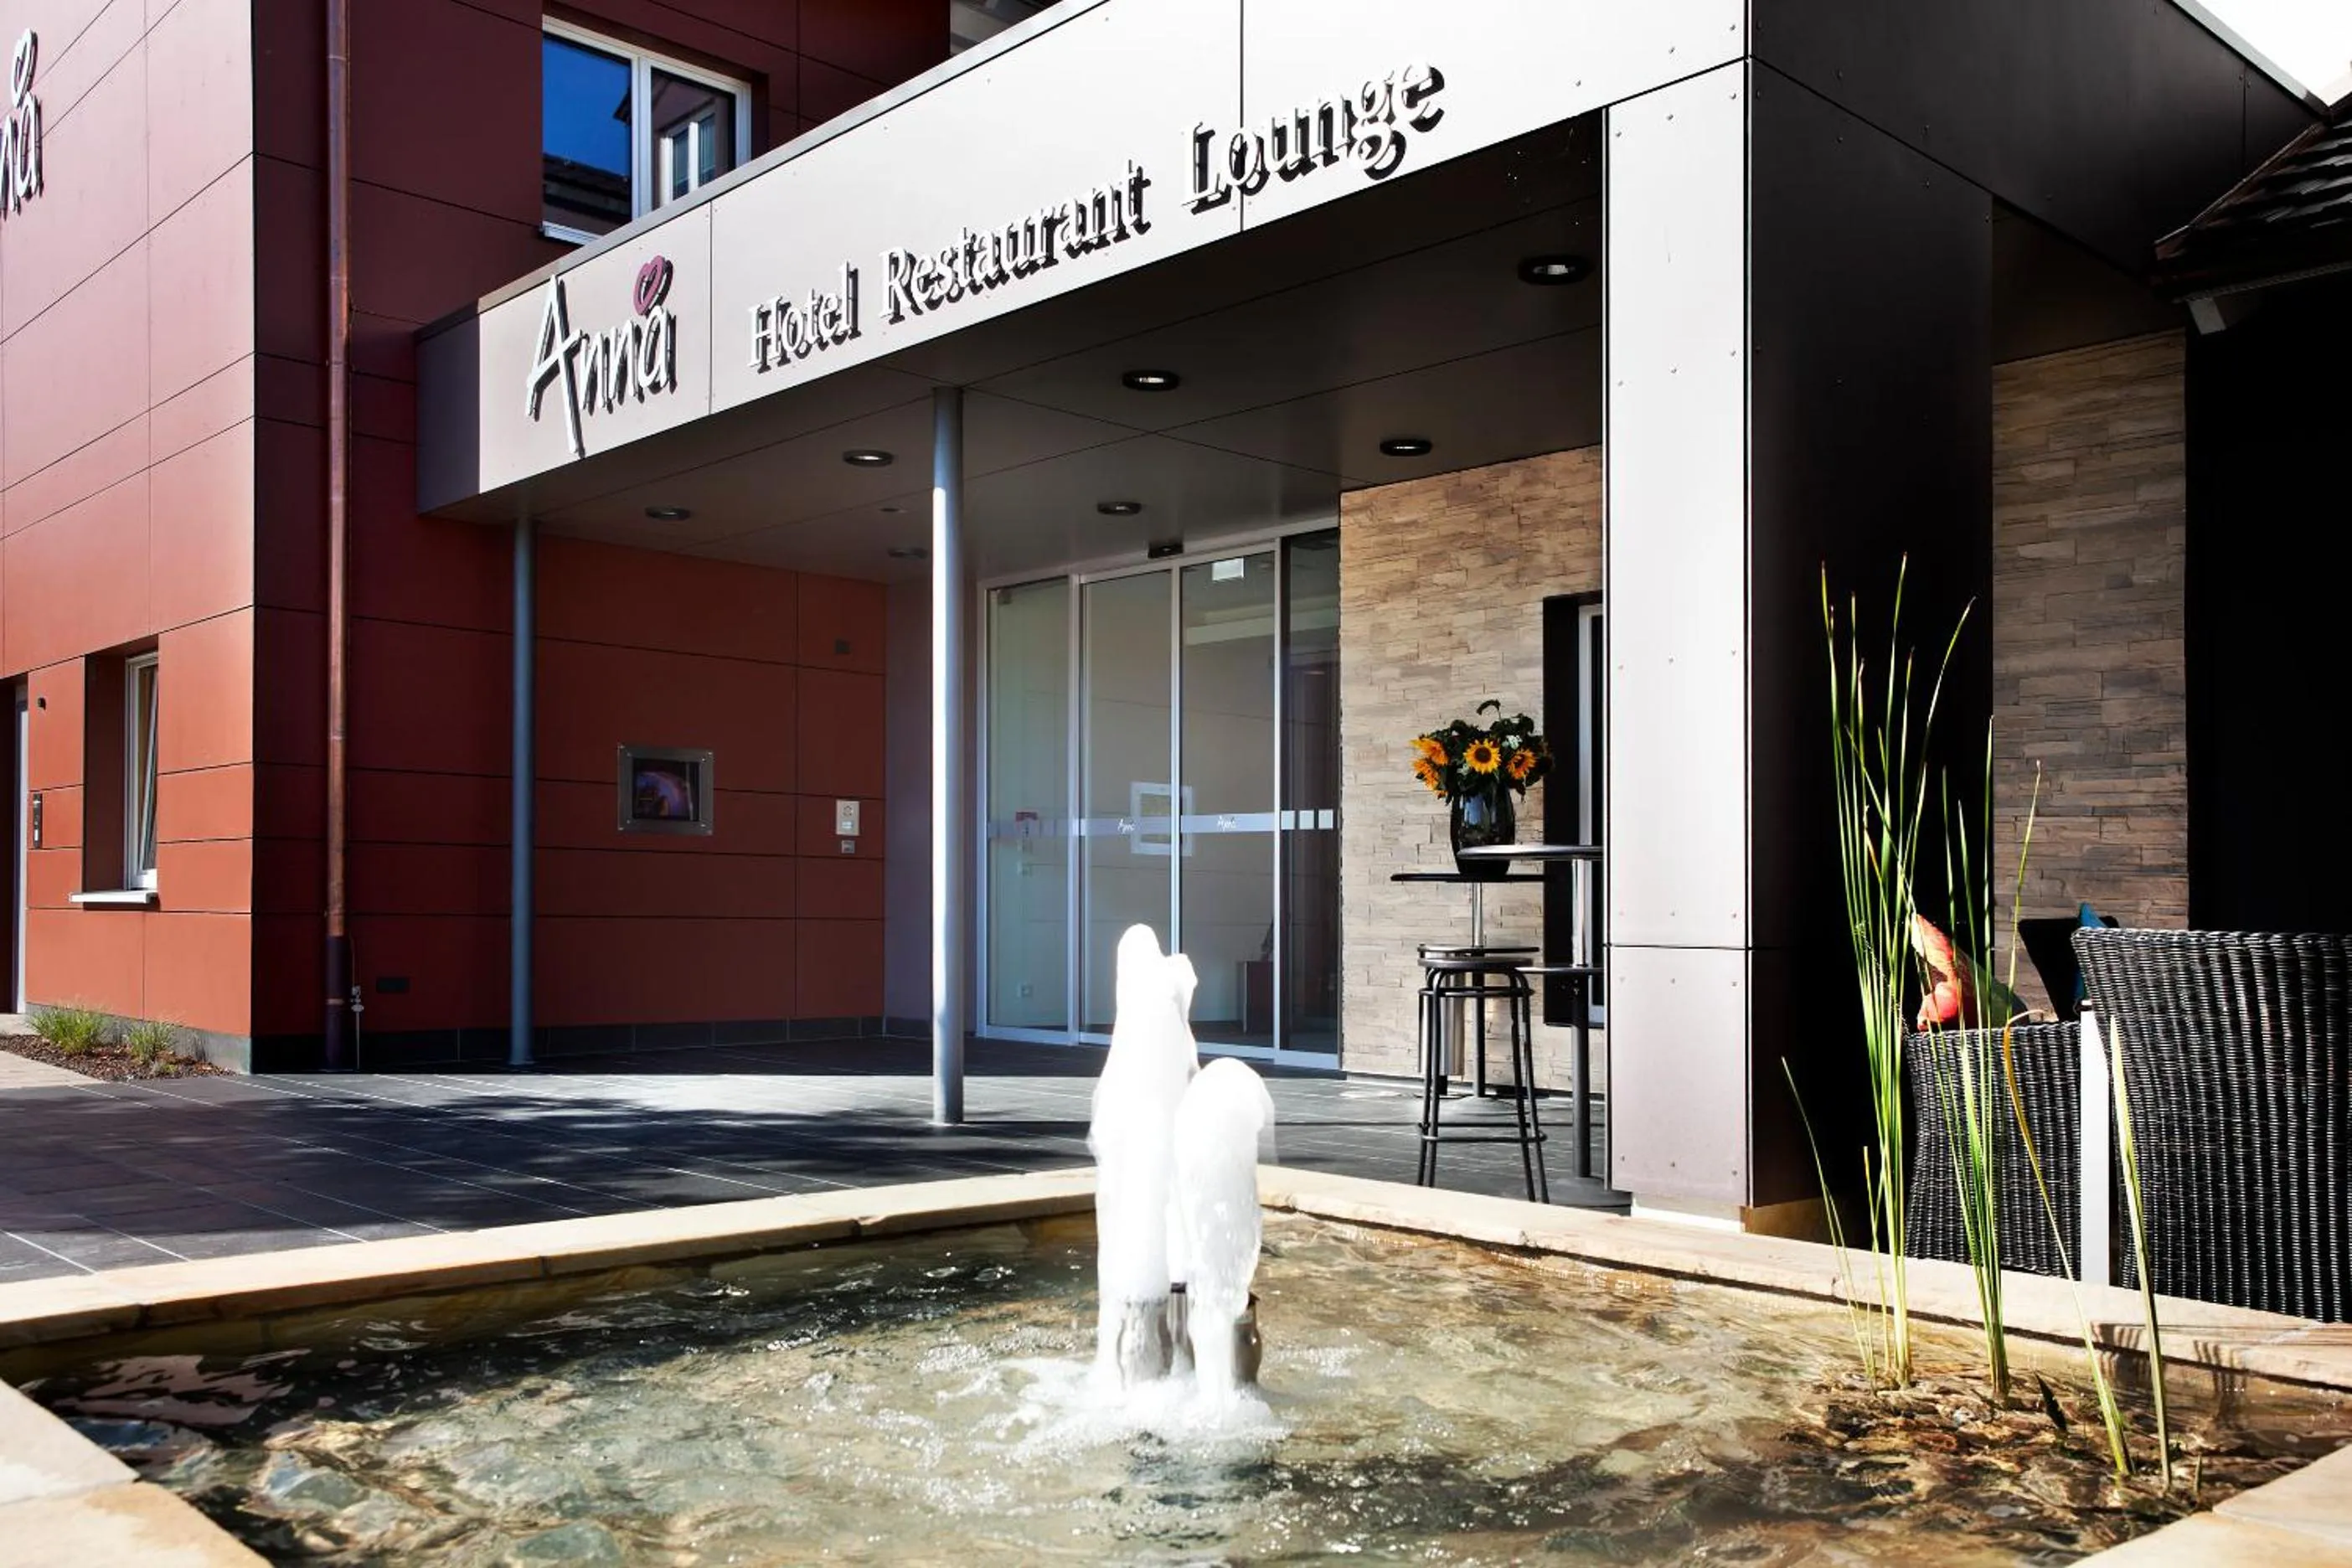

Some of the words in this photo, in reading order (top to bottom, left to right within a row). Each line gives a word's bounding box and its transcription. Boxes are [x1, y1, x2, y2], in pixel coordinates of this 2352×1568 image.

[525, 268, 673, 456] Anna
[747, 260, 859, 372] Hotel
[879, 161, 1149, 323] Restaurant
[1180, 62, 1444, 215] Lounge
